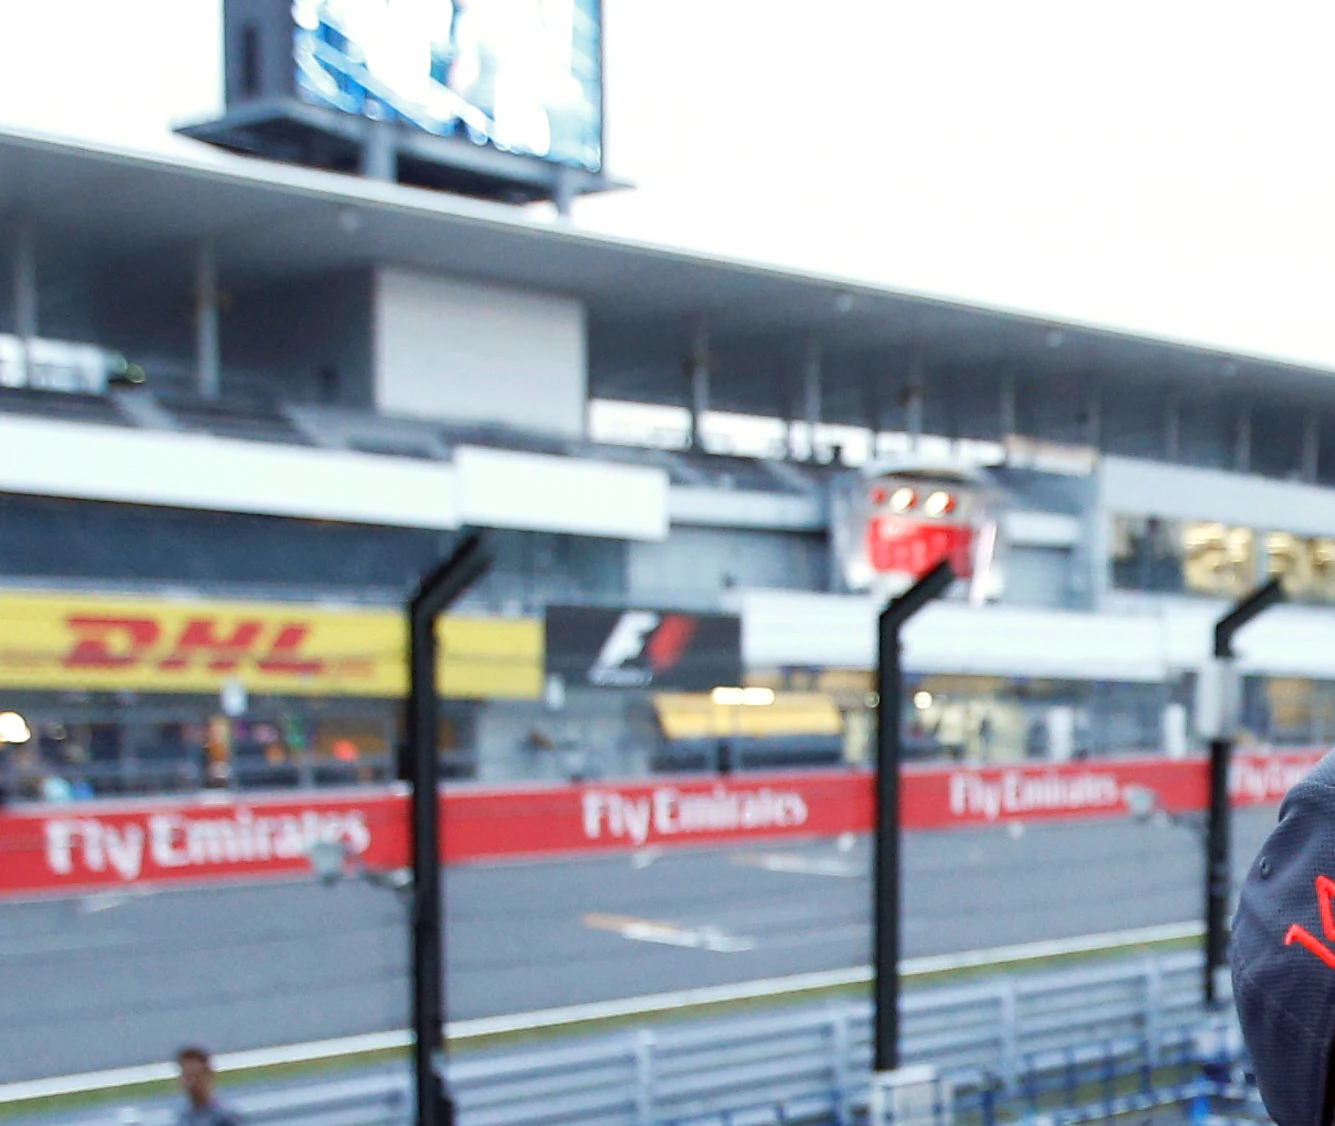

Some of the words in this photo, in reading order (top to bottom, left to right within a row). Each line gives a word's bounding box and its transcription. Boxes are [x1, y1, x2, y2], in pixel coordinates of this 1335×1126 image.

[64, 613, 322, 674] DHL
[45, 815, 145, 881] Fly
[148, 803, 372, 867] Emirates
[582, 787, 650, 846] Fly
[652, 781, 809, 835] Emirates
